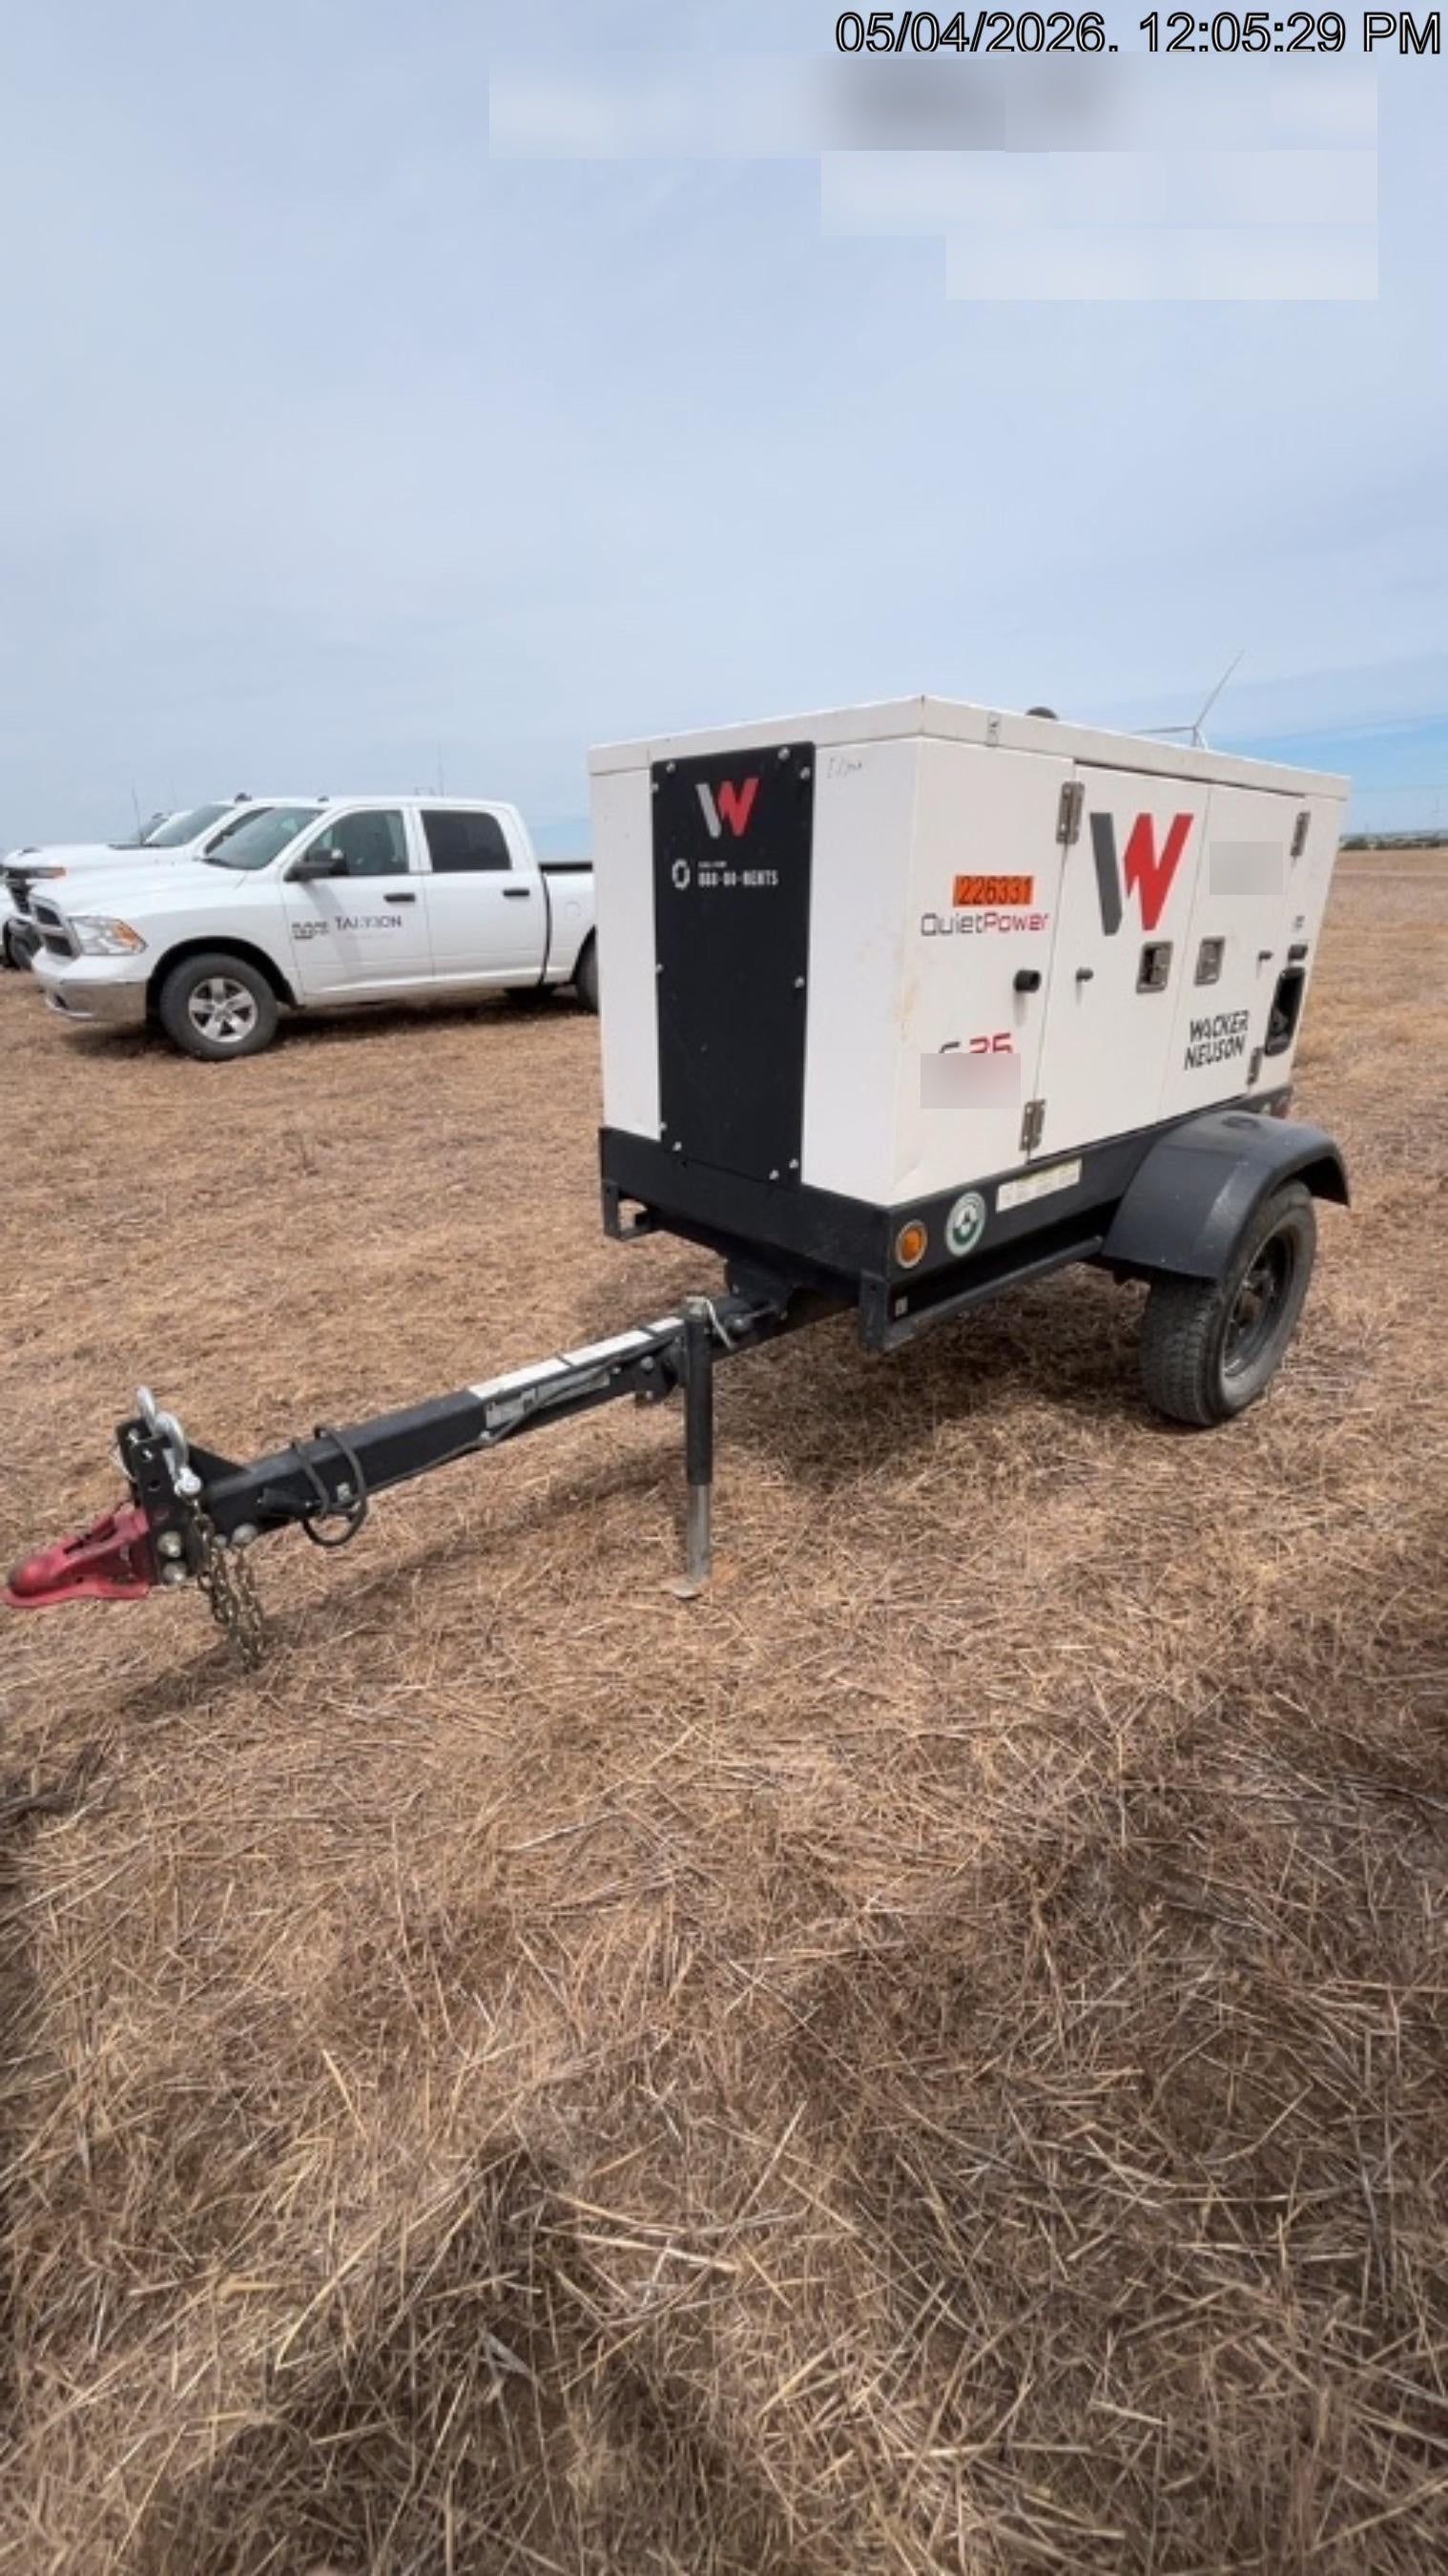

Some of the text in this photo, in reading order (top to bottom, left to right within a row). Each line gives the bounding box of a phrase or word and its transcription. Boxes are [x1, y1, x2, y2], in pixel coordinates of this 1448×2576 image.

[958, 875, 1033, 905] 226331
[921, 911, 1050, 936] QuietPower
[1189, 1009, 1249, 1043] WACKER
[1184, 1035, 1245, 1070] NEUSON
